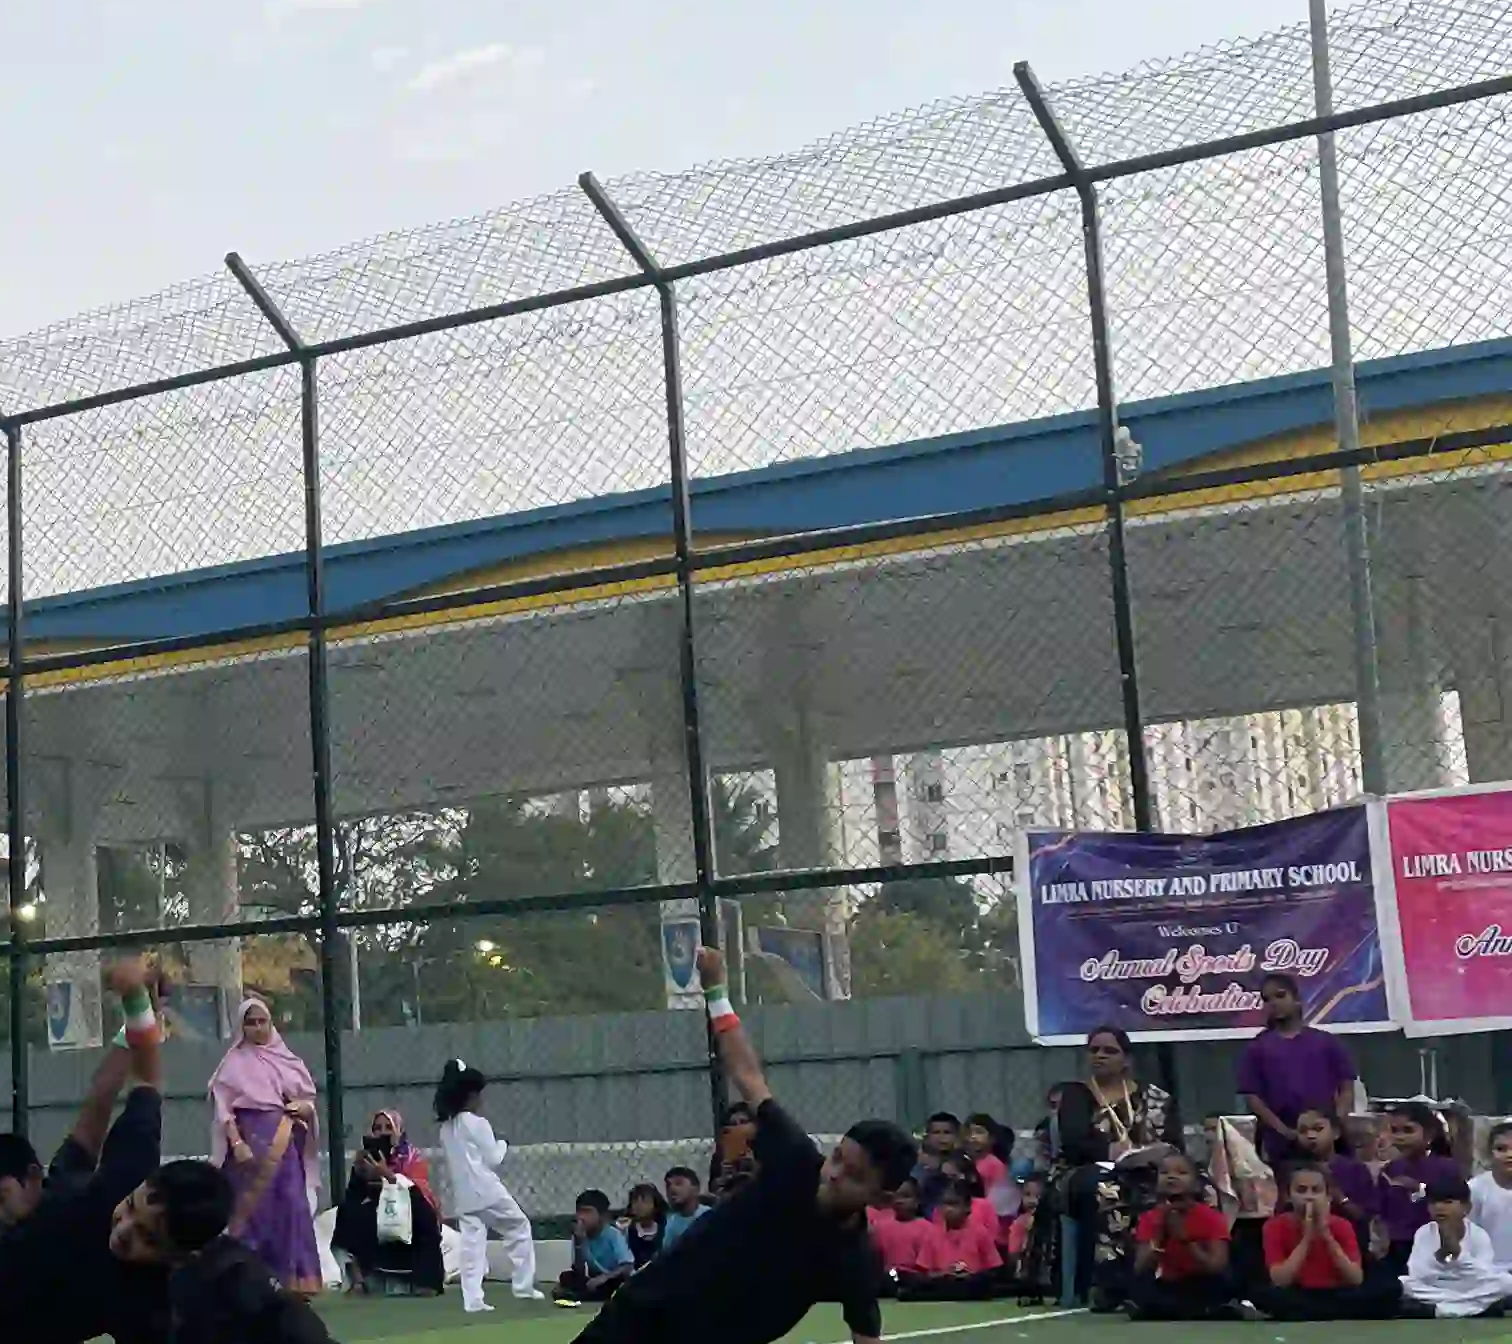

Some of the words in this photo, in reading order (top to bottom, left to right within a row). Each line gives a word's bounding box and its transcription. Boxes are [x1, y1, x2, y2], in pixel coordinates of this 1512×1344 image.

[1041, 881, 1089, 905] LIMRA
[1091, 877, 1168, 901] NURSERY
[1168, 875, 1207, 896] AND
[1210, 867, 1284, 893] PRIMARY
[1288, 860, 1362, 887] SCHOOL
[1402, 853, 1462, 878] LIMRA
[1080, 948, 1178, 982] Annual
[1175, 943, 1256, 983] Sports
[1259, 938, 1329, 977] Day
